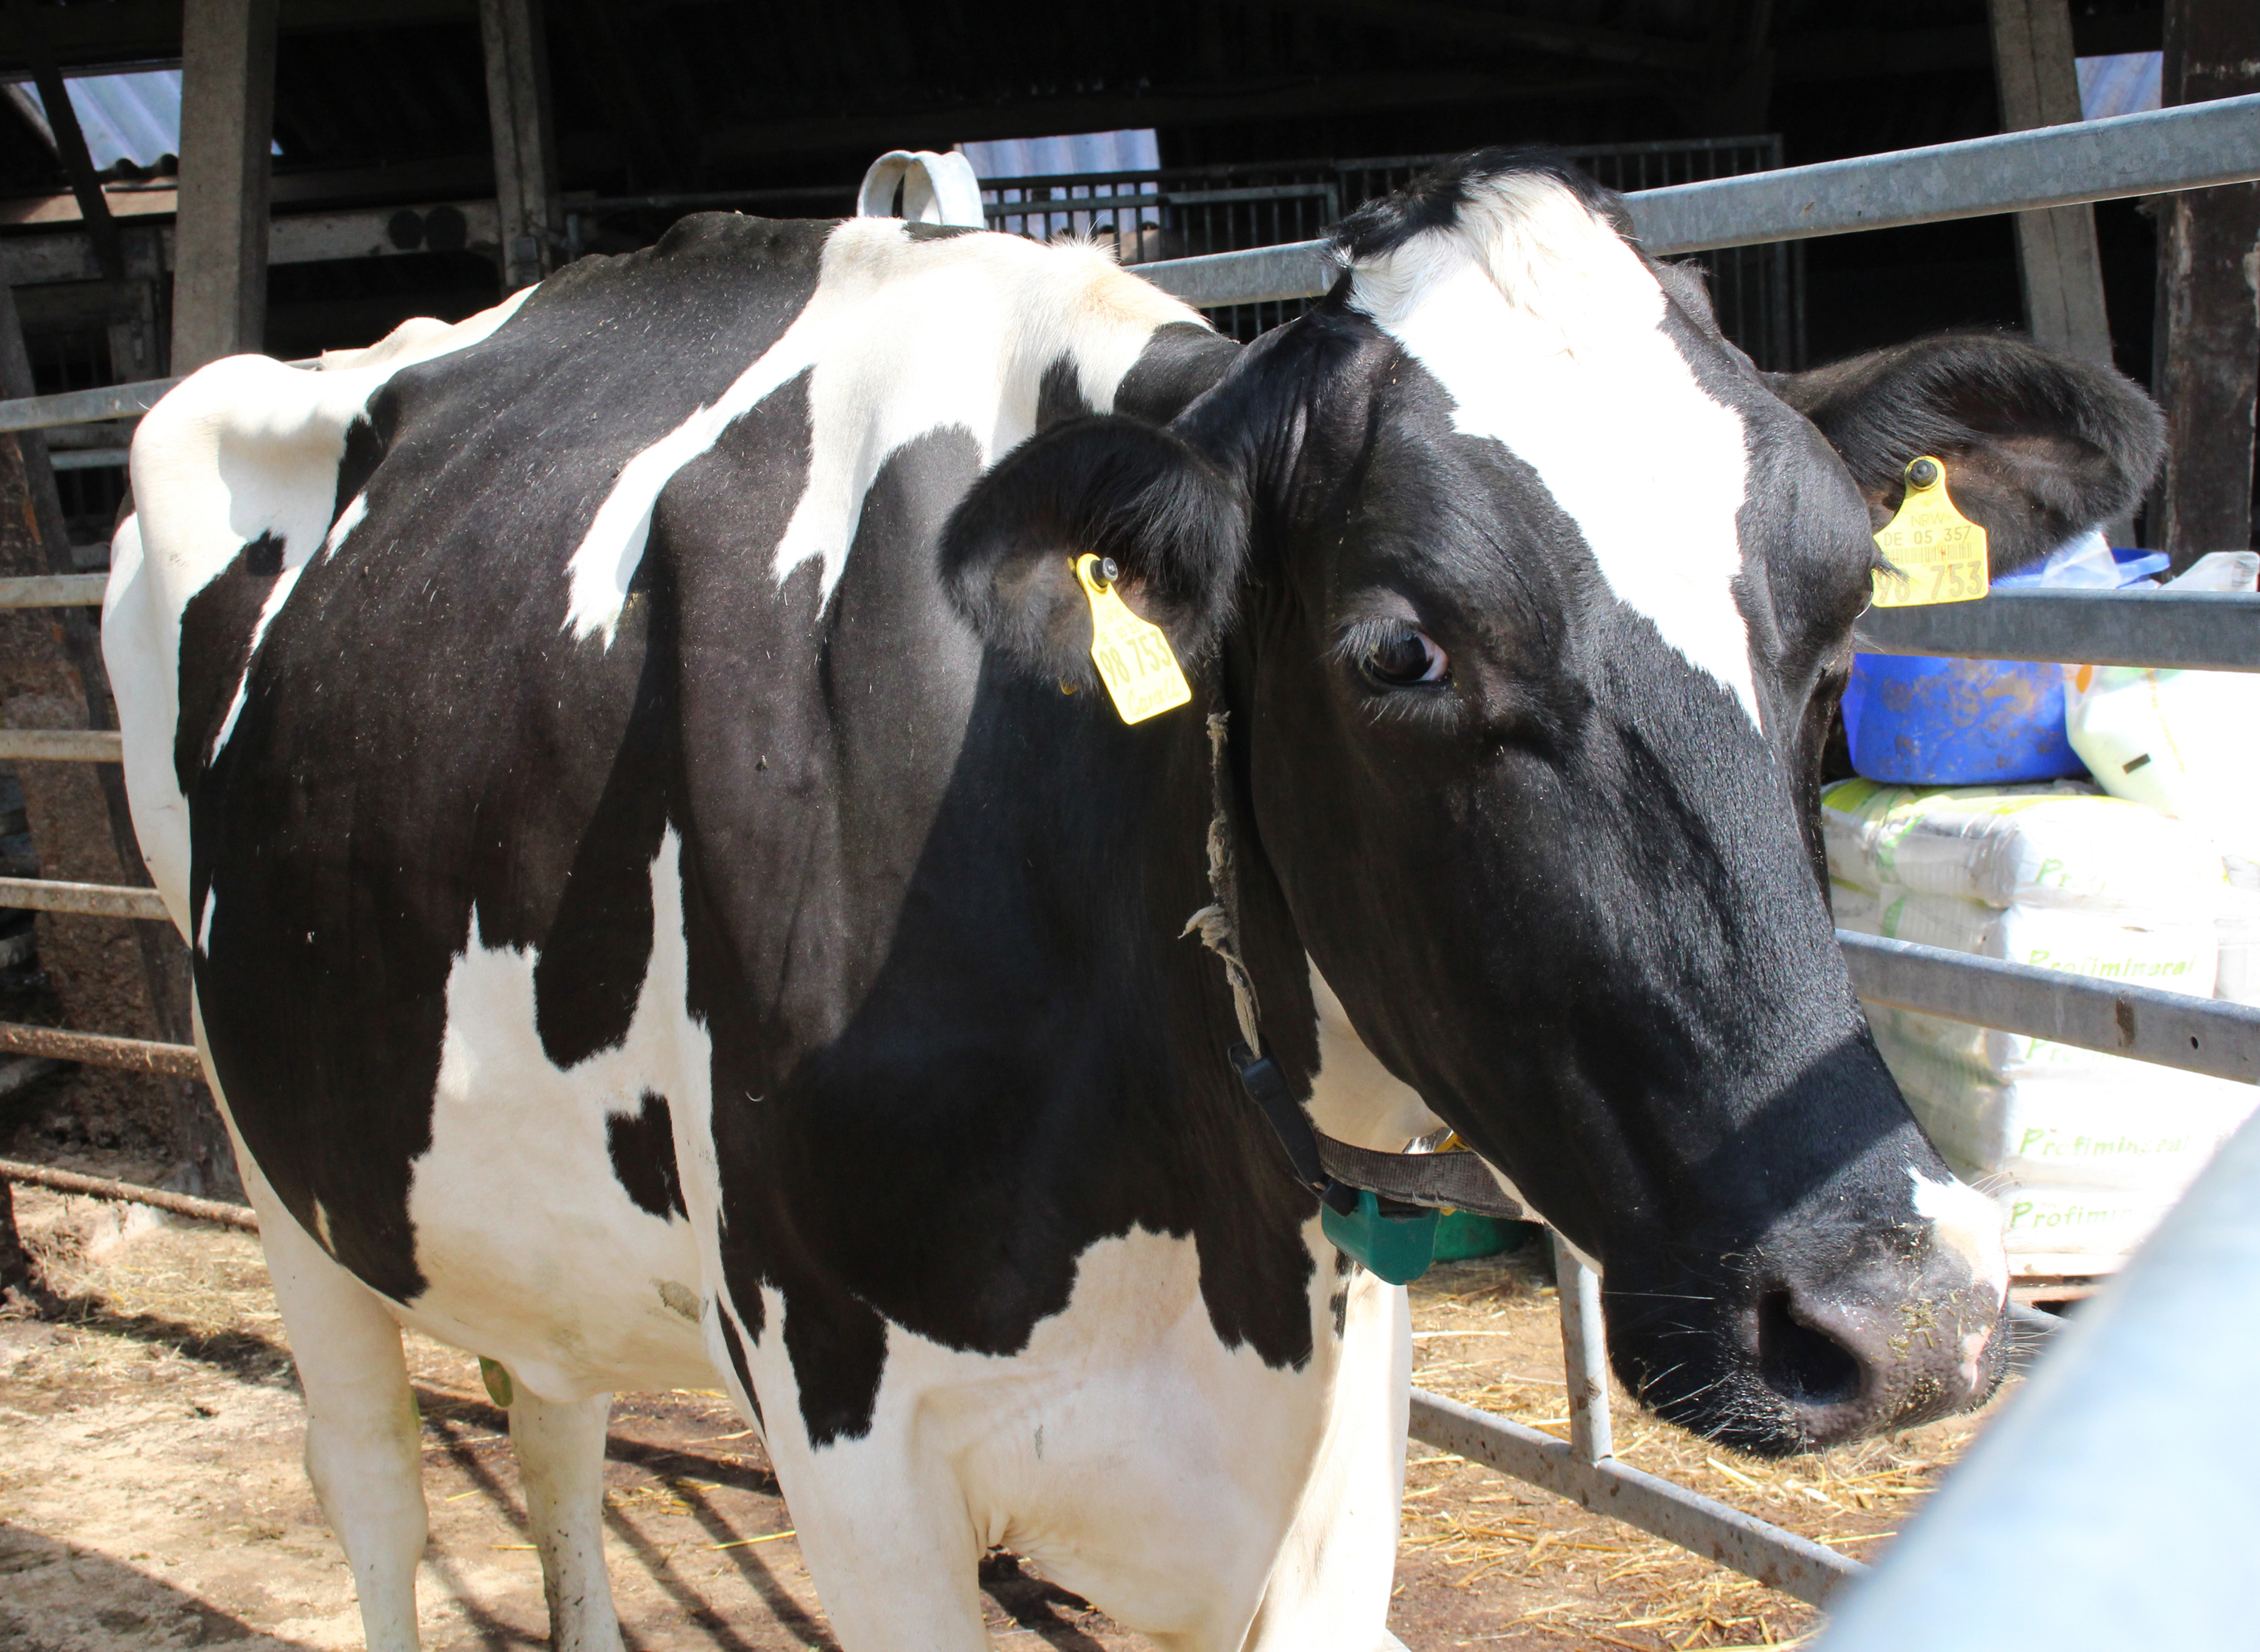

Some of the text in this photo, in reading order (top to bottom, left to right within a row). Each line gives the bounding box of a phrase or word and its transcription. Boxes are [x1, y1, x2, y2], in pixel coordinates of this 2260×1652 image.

[1910, 512, 1945, 527] NRW
[1883, 531, 1904, 547] DE
[1944, 525, 1972, 542] 357
[1929, 560, 1983, 600] 753
[1098, 632, 1111, 646] DE
[1099, 630, 1172, 688] 98 753
